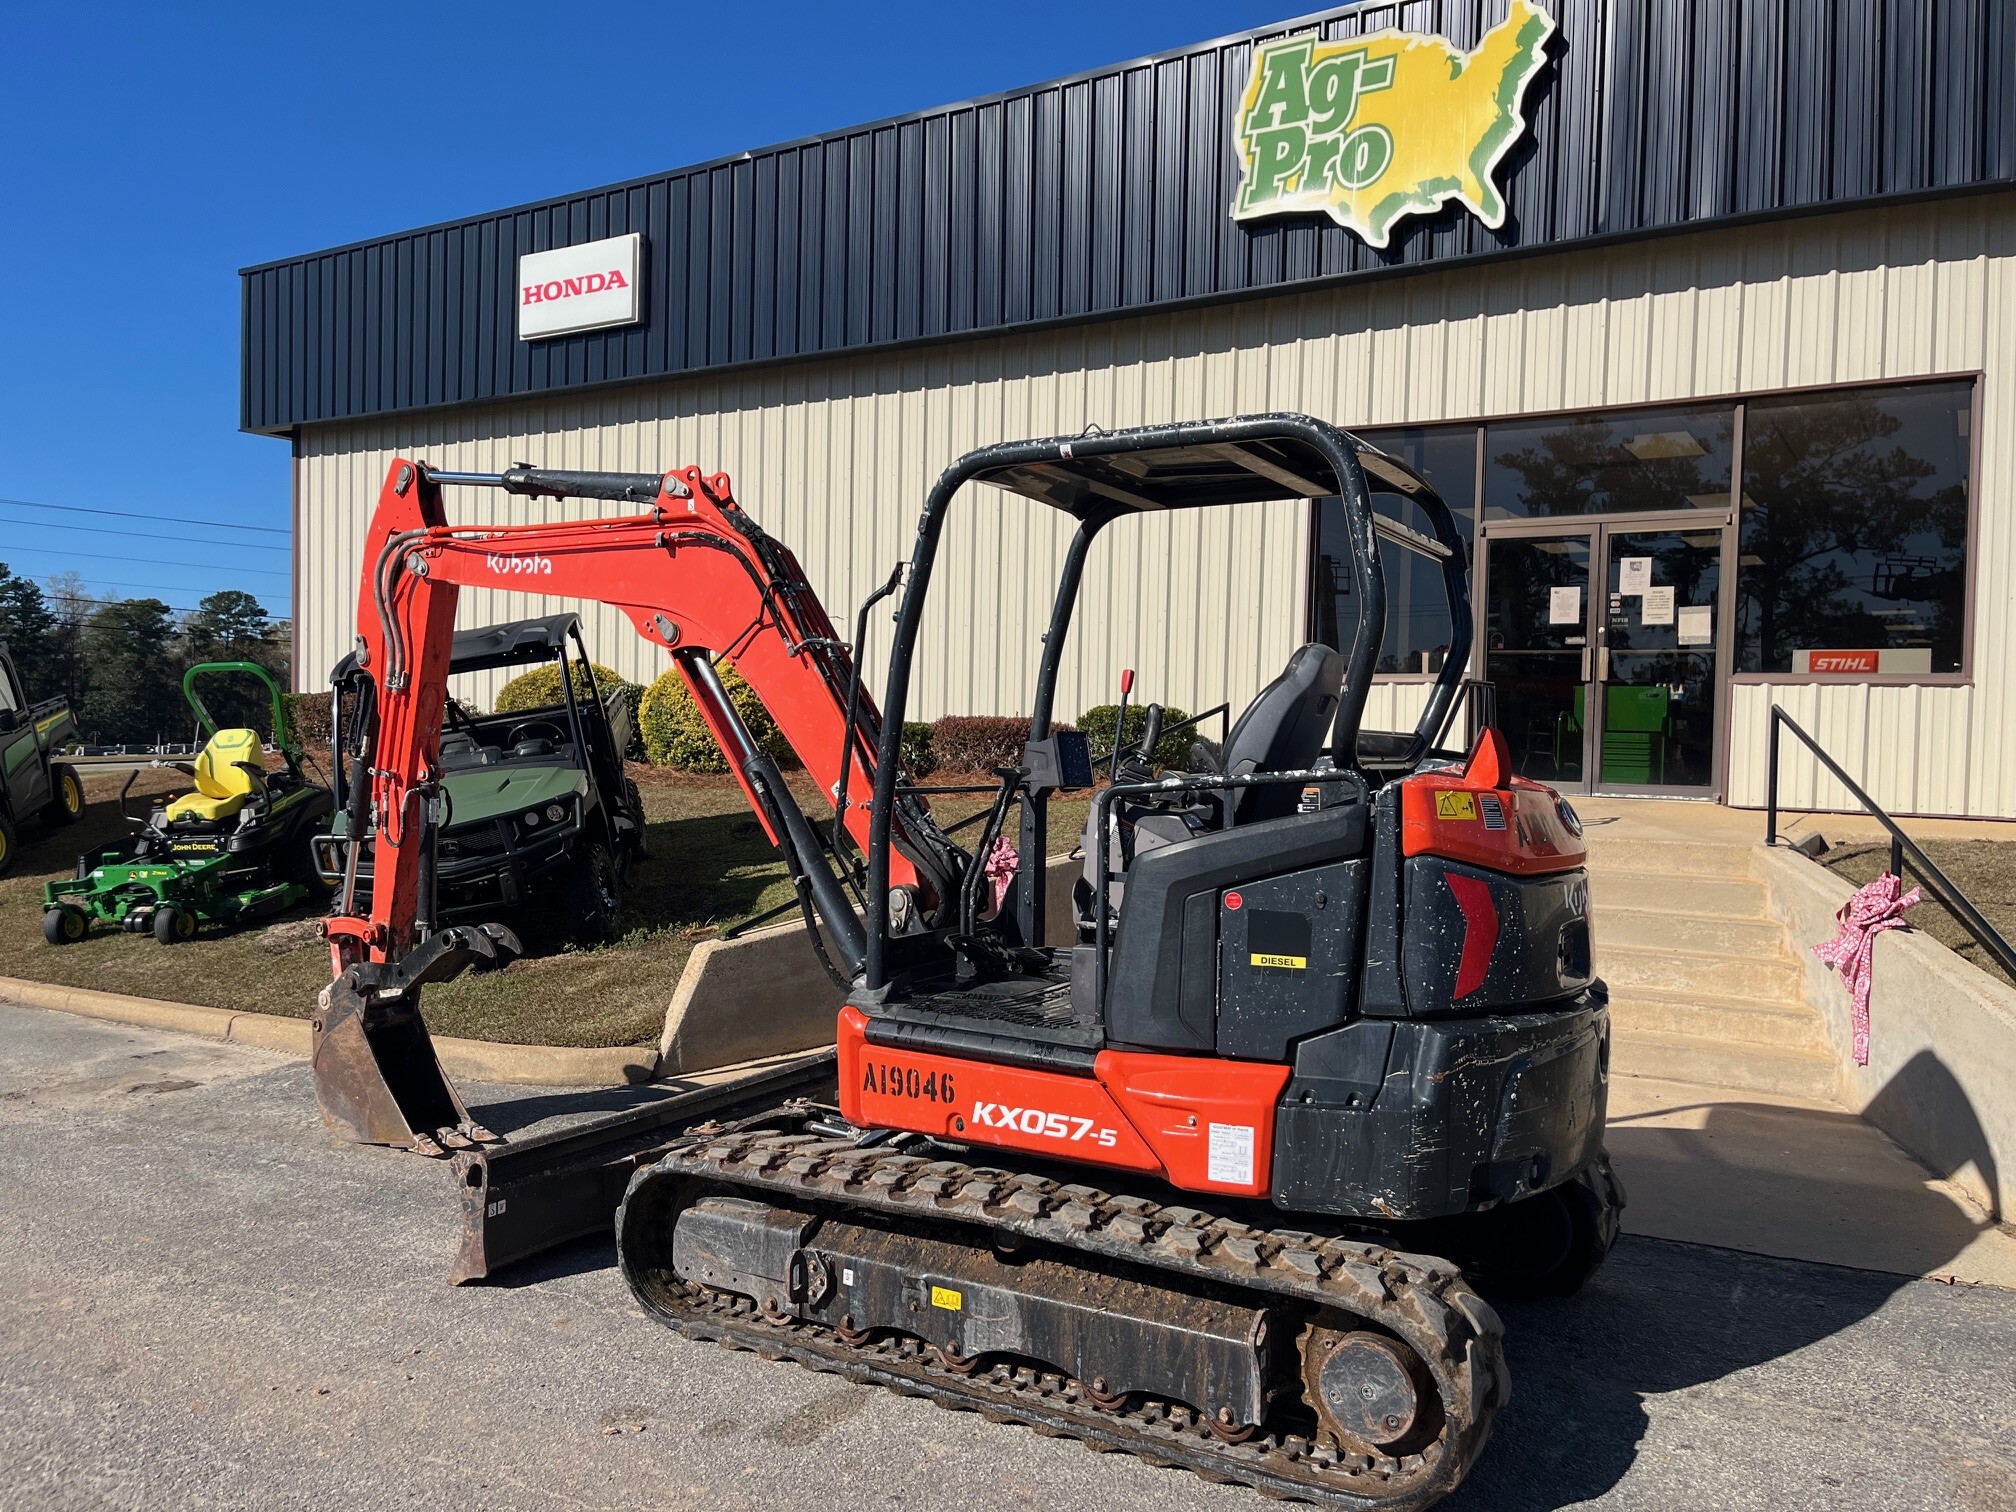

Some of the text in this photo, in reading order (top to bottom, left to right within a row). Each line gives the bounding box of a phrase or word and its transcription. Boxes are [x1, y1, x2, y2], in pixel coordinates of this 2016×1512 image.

[1243, 42, 1396, 137] Ag-
[1240, 124, 1394, 211] Pro
[522, 269, 629, 305] HONDA
[486, 552, 552, 575] Kubota
[1814, 658, 1871, 671] STIHL
[172, 843, 216, 851] JOHN DEERE
[1260, 956, 1297, 967] DIESEL
[863, 1062, 955, 1105] A19046
[971, 1101, 1117, 1148] KX057-5
